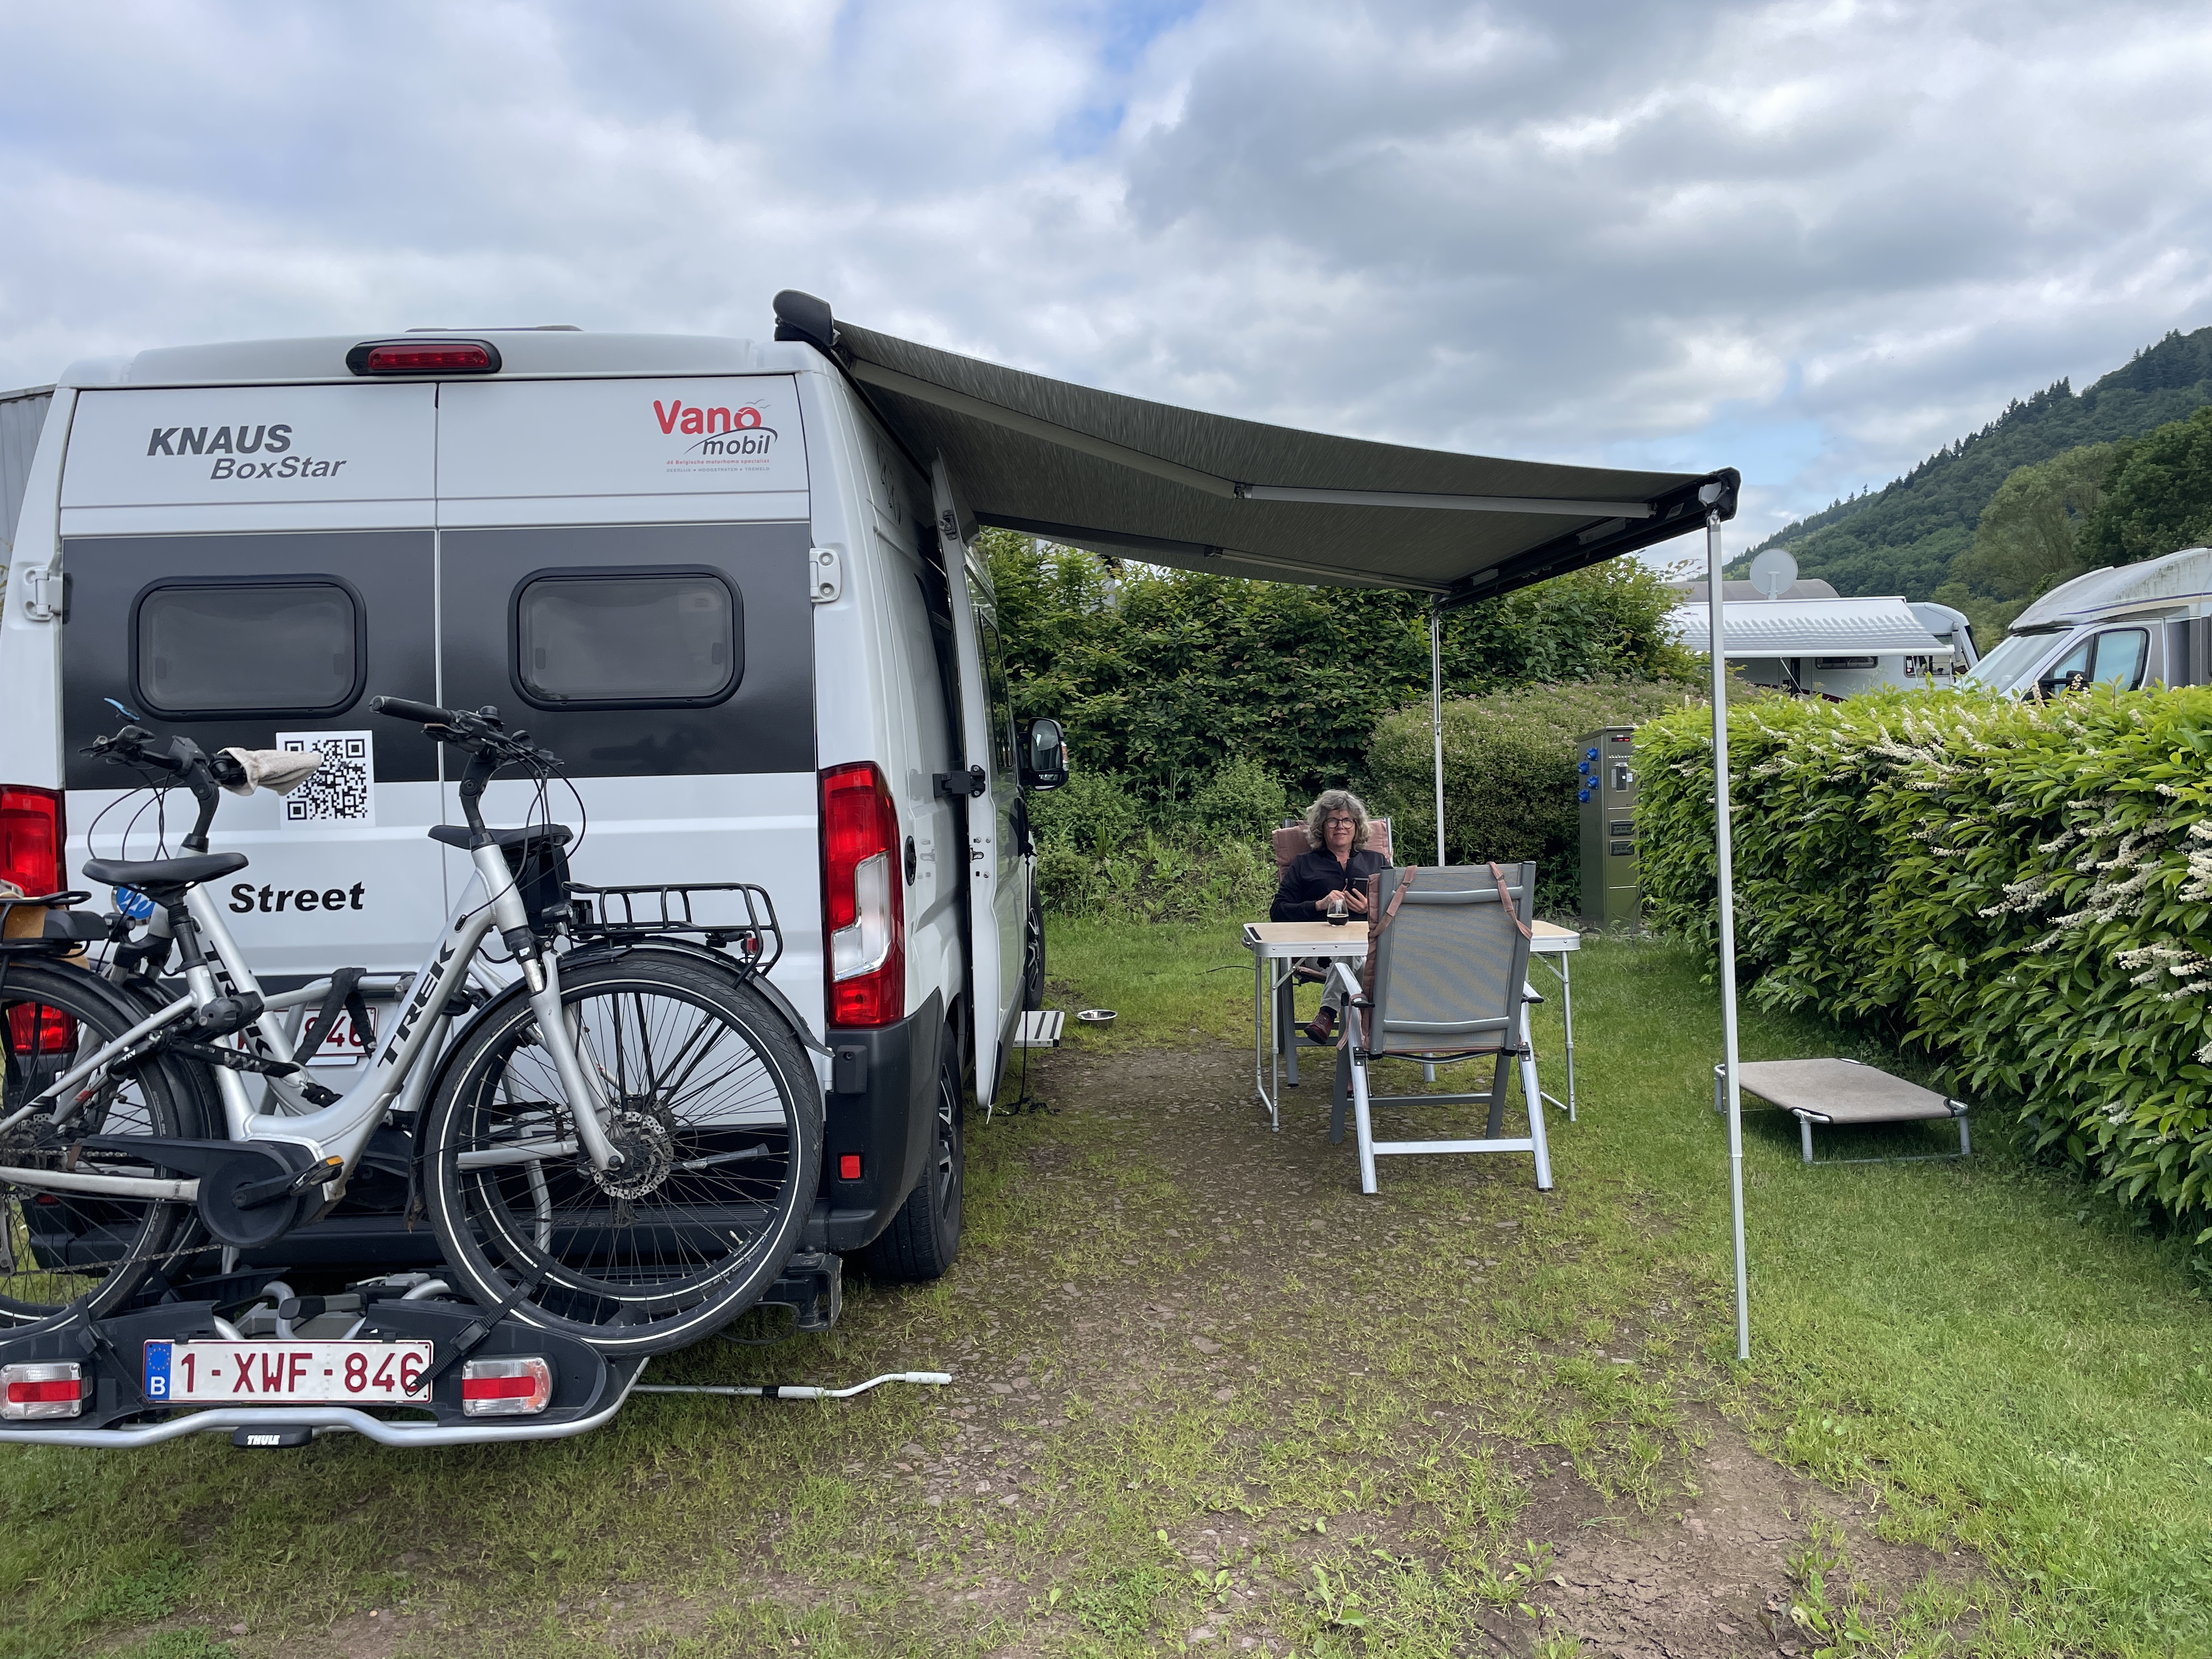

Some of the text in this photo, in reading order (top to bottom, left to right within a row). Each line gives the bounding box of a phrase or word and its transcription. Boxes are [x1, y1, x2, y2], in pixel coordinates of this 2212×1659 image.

[653, 399, 761, 435] Vano
[146, 424, 293, 456] KNAUS
[703, 435, 770, 455] mobil
[210, 456, 347, 479] BoxStar
[229, 881, 365, 913] Street
[377, 939, 456, 1069] TREK
[150, 1376, 165, 1395] B
[182, 1352, 424, 1393] 1-XWF-846
[247, 1435, 280, 1446] THULE
